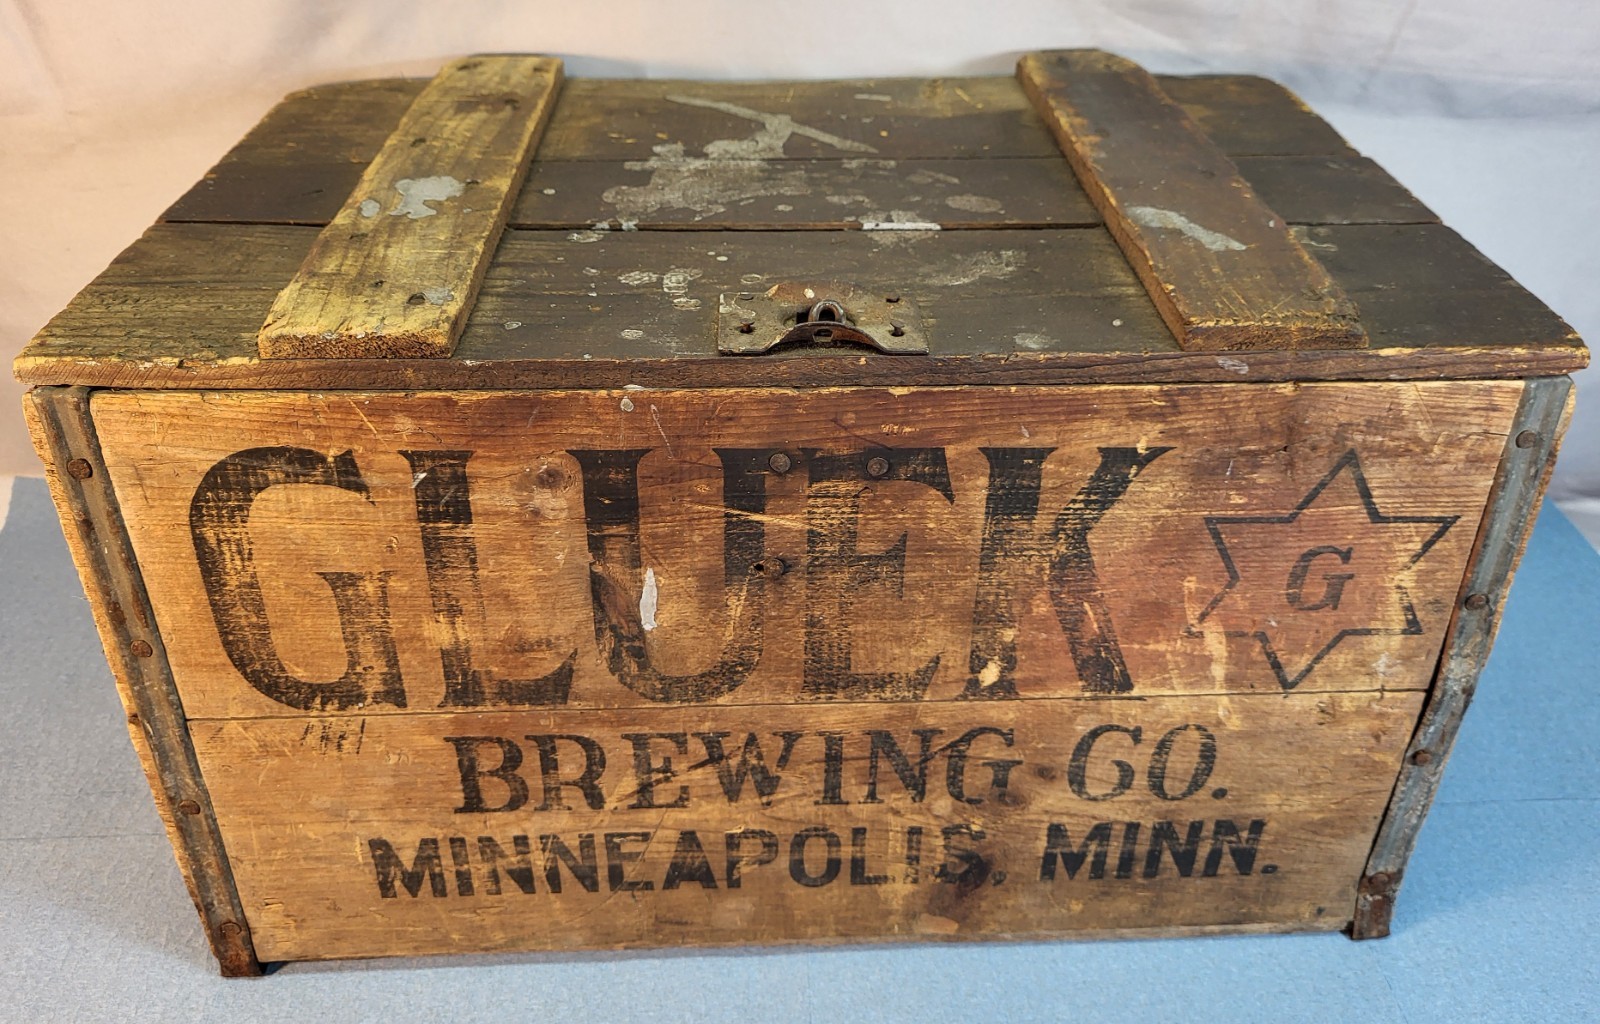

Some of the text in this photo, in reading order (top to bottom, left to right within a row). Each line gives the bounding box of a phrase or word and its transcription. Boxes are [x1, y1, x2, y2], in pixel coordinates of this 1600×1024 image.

[190, 445, 1176, 711] GLUEK
[1286, 545, 1355, 611] G
[445, 726, 1022, 814] BREWING
[1039, 819, 1279, 882] MINN.
